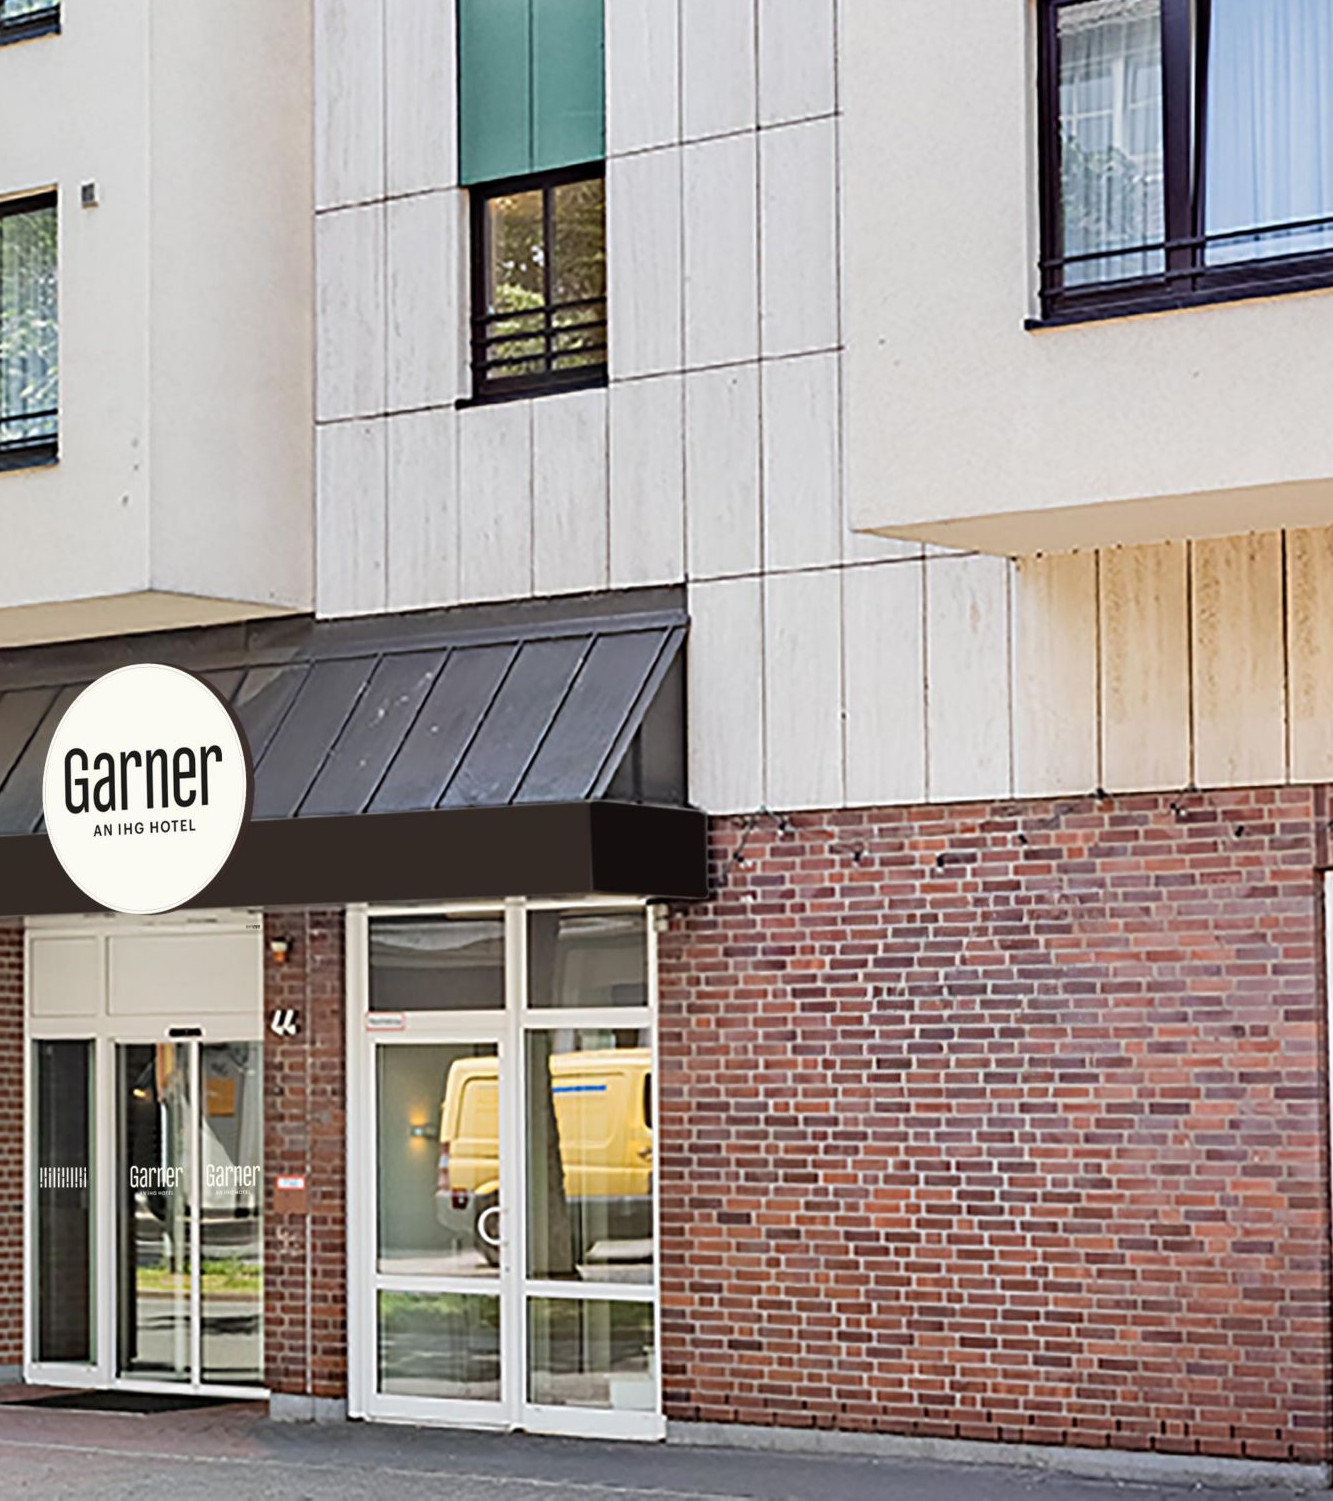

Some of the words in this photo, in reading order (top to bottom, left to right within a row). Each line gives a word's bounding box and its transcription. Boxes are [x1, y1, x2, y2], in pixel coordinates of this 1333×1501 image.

[64, 744, 223, 814] Garner
[93, 823, 113, 837] AN
[118, 821, 145, 836] IHG
[149, 818, 196, 834] HOTEL
[130, 1165, 183, 1188] Garner
[205, 1164, 260, 1187] Garner
